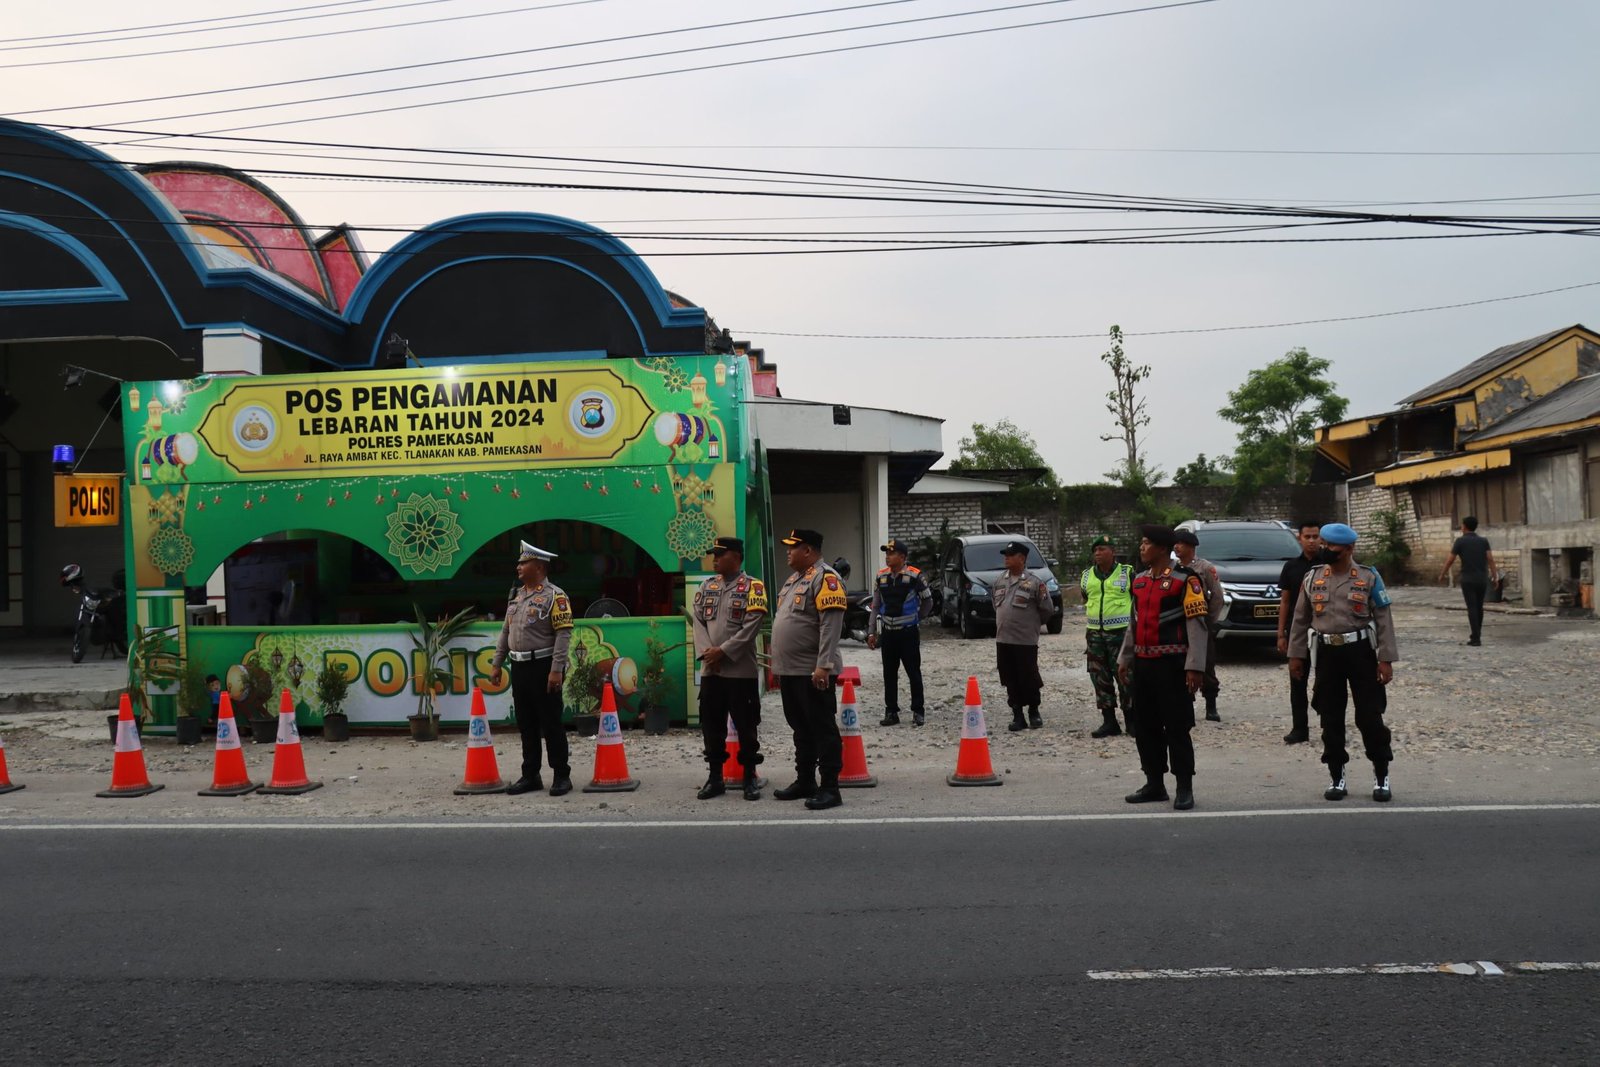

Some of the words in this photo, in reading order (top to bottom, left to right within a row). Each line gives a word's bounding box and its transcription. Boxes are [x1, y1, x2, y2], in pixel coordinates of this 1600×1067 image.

[286, 388, 342, 414] POS
[352, 379, 557, 411] PENGAMANAN
[299, 414, 398, 436] LEBARAN
[407, 411, 482, 431] TAHUN
[491, 408, 544, 427] 2024
[304, 454, 317, 463] JL.
[320, 453, 344, 463] RAYA
[346, 451, 378, 461] AMBAT
[381, 450, 402, 460] KEC.
[404, 447, 455, 459] TLANAKAN
[457, 446, 480, 457] KAB.
[482, 444, 542, 456] PAMEKASAN
[348, 435, 403, 449] POLRES
[407, 431, 494, 447] PAMEKASAN
[69, 486, 114, 517] POLISI
[324, 646, 512, 697] POLIS
